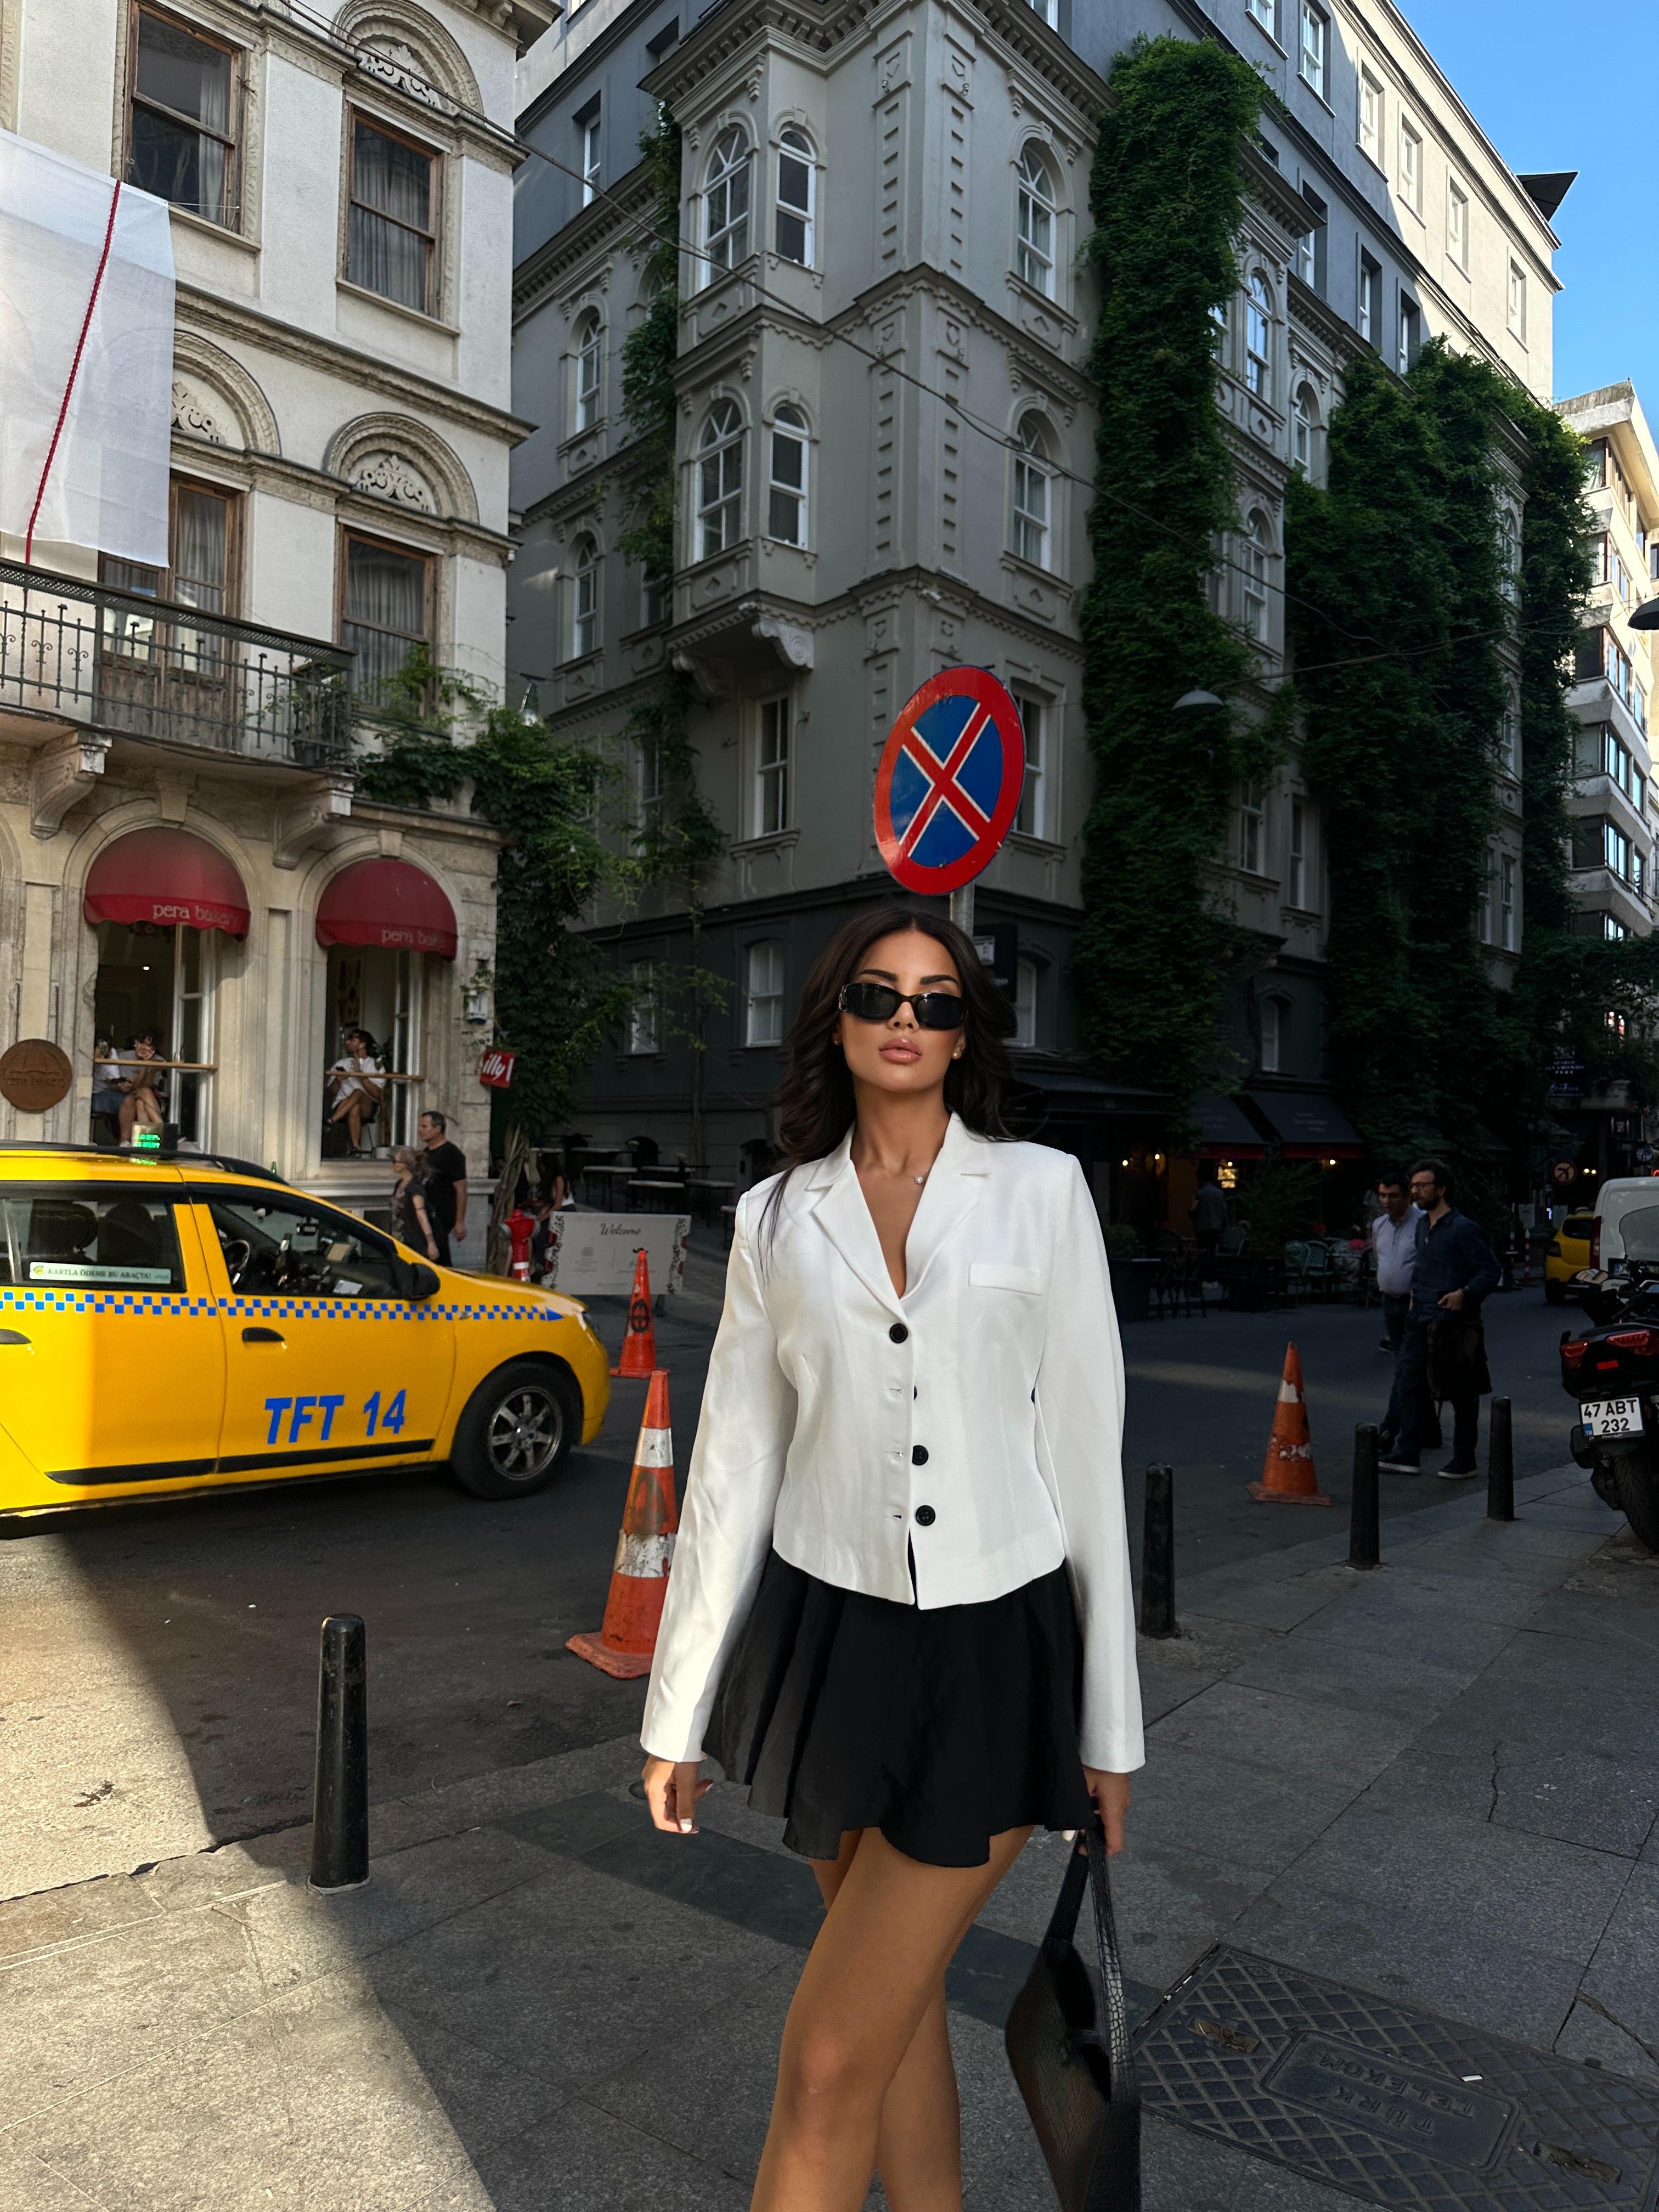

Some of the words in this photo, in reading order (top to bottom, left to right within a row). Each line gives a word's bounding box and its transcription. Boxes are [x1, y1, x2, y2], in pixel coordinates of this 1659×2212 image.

[152, 904, 190, 919] pera
[381, 929, 413, 944] pera
[483, 1053, 506, 1081] illy
[600, 1222, 642, 1236] Welcome
[80, 1268, 106, 1277] ÖDEME
[264, 1394, 345, 1444] TFT
[363, 1389, 405, 1437] 14
[1584, 1403, 1601, 1418] 47
[1605, 1399, 1637, 1416] ABT
[1601, 1417, 1630, 1434] 232
[1318, 2052, 1475, 2121] TELEKOM
[1333, 2085, 1434, 2136] TÜRK
